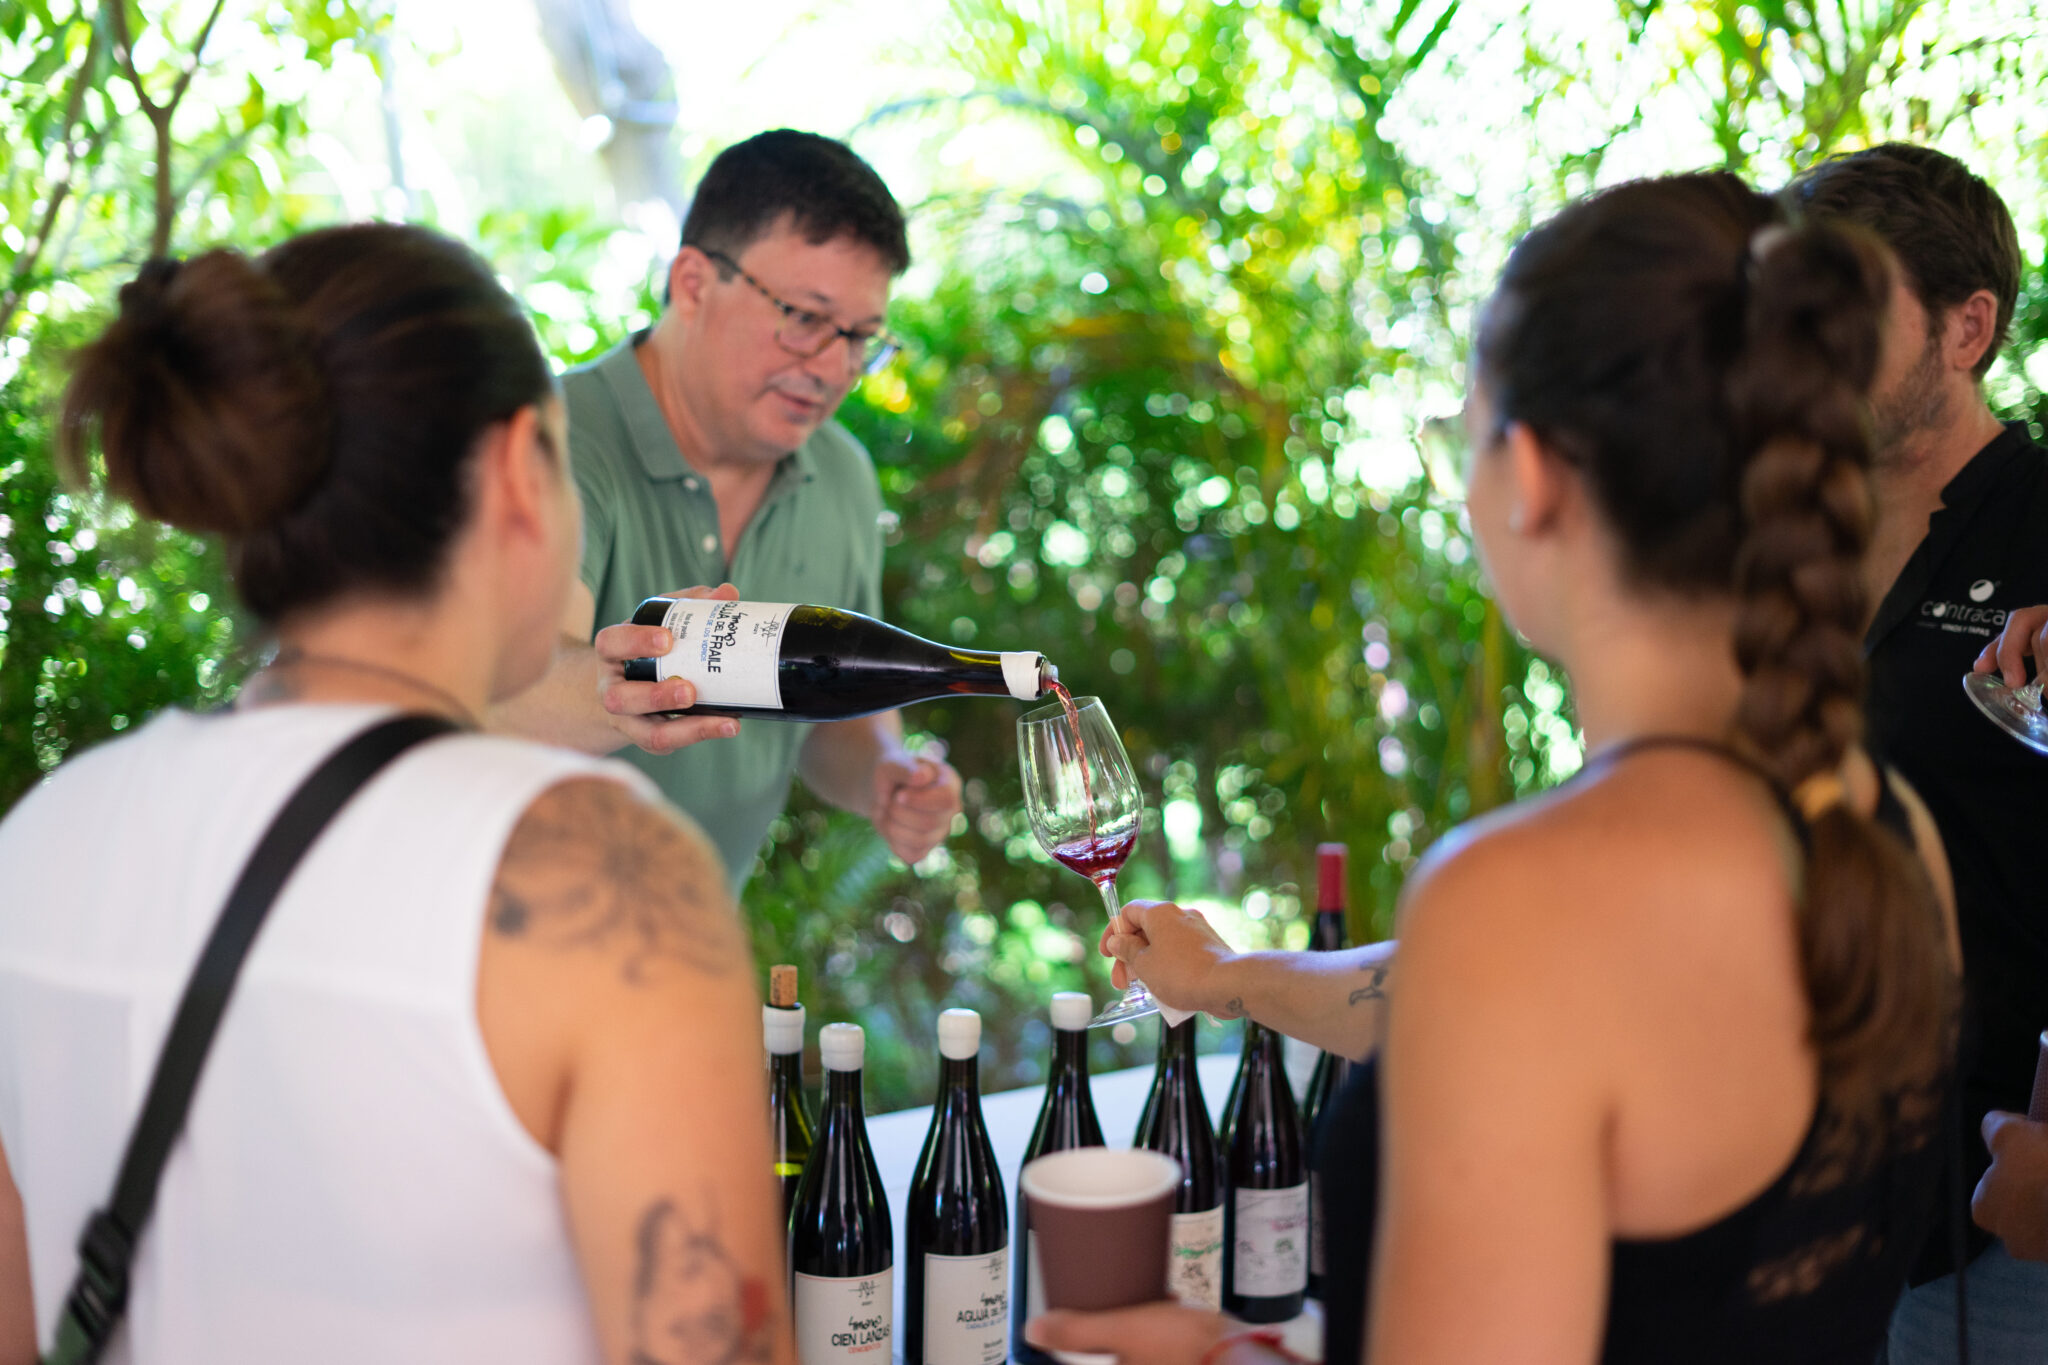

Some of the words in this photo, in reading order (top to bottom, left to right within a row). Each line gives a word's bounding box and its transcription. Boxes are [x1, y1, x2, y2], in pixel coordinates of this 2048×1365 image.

[1921, 600, 2007, 626] contraca
[714, 621, 725, 633] DEL
[707, 634, 723, 673] FRAILE
[831, 1332, 857, 1346] CIEN
